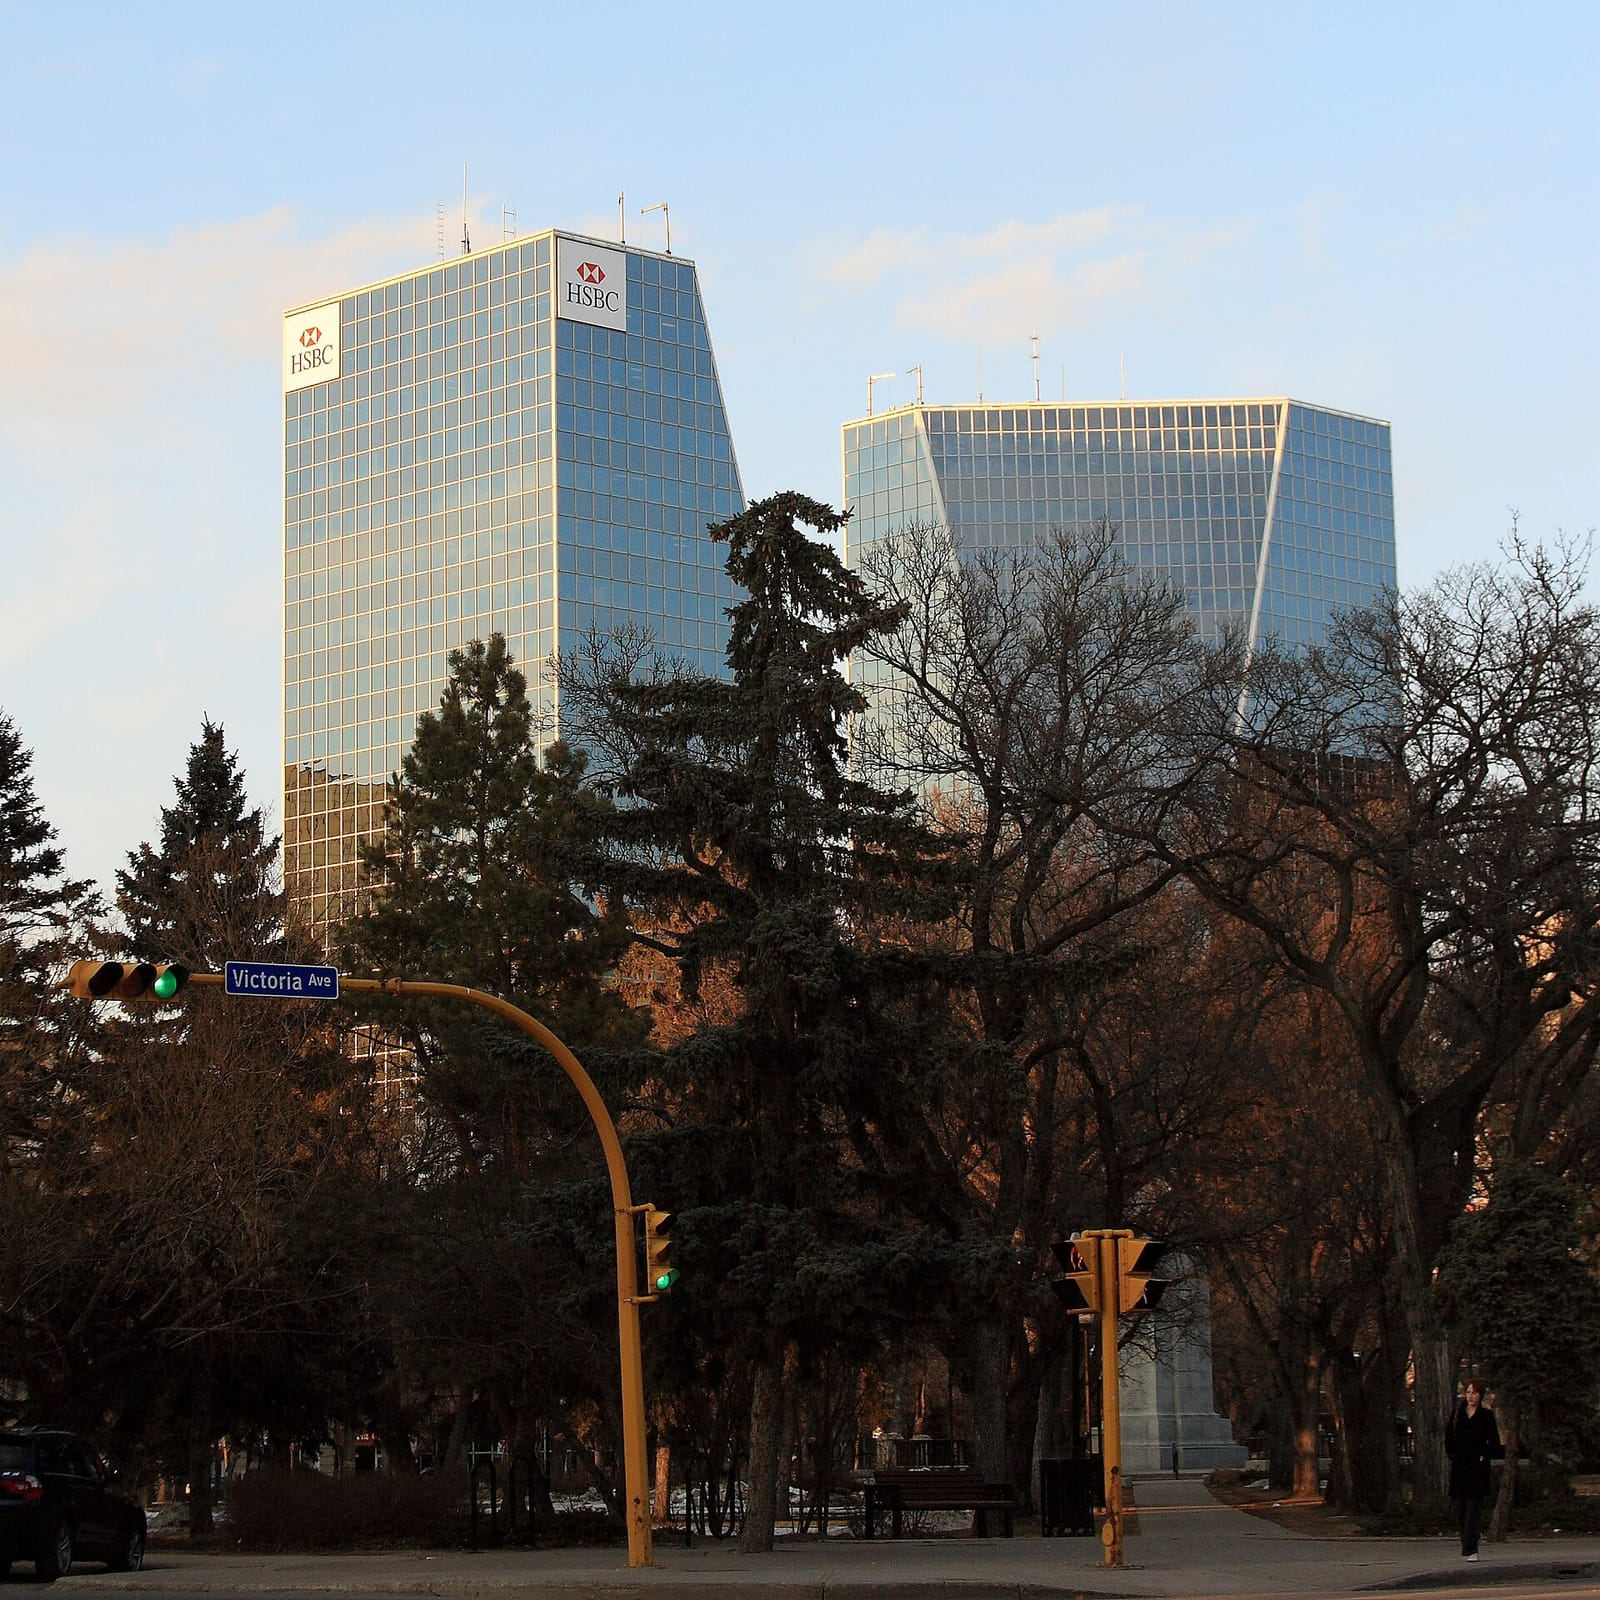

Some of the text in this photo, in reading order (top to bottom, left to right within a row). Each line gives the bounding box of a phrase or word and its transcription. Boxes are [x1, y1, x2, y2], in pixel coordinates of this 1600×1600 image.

[566, 281, 619, 312] HSBC
[291, 344, 333, 374] HSBC
[232, 969, 331, 990] Victoria Ave
